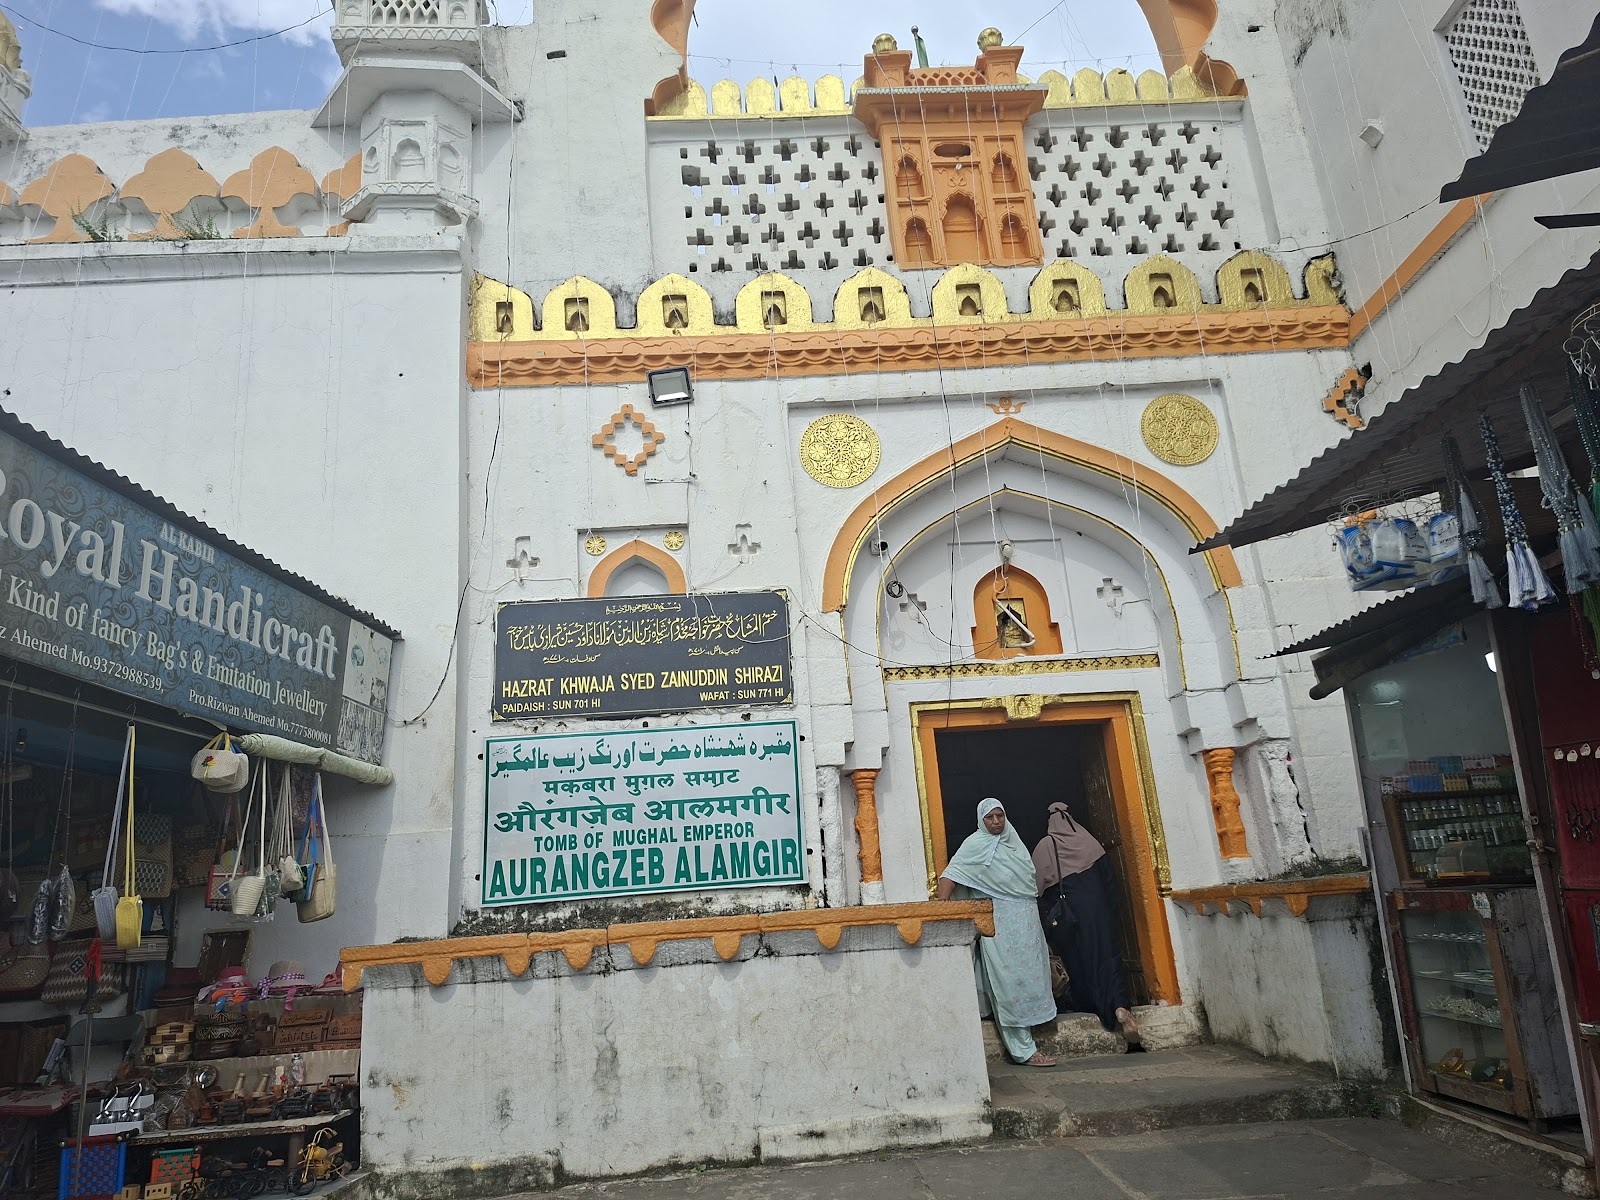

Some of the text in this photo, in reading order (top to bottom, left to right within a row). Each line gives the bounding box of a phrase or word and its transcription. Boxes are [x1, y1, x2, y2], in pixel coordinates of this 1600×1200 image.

[160, 522, 215, 565] AL KABIR
[135, 538, 338, 680] Handicraft
[7, 575, 327, 722] Kind of fancy Bag's & Emitation Jewellery
[10, 628, 68, 660] Ahemed
[502, 665, 783, 698] HAZRAT KHWAJA SYED ZAINUDDIN SHIRAZI
[699, 690, 730, 702] WAFAT
[737, 689, 756, 699] SUN
[758, 688, 773, 698] 771
[774, 687, 784, 697] HI
[241, 705, 276, 727] Ahemed
[502, 702, 545, 713] PAIDAISH
[552, 699, 572, 710] SUN
[574, 698, 589, 709] 701
[591, 698, 601, 708] HI
[644, 786, 791, 821] आलमगीर
[534, 821, 754, 852] TOMB OF MUGHAL EMPEROR
[489, 838, 799, 898] AURANGZEB ALAMGIR
